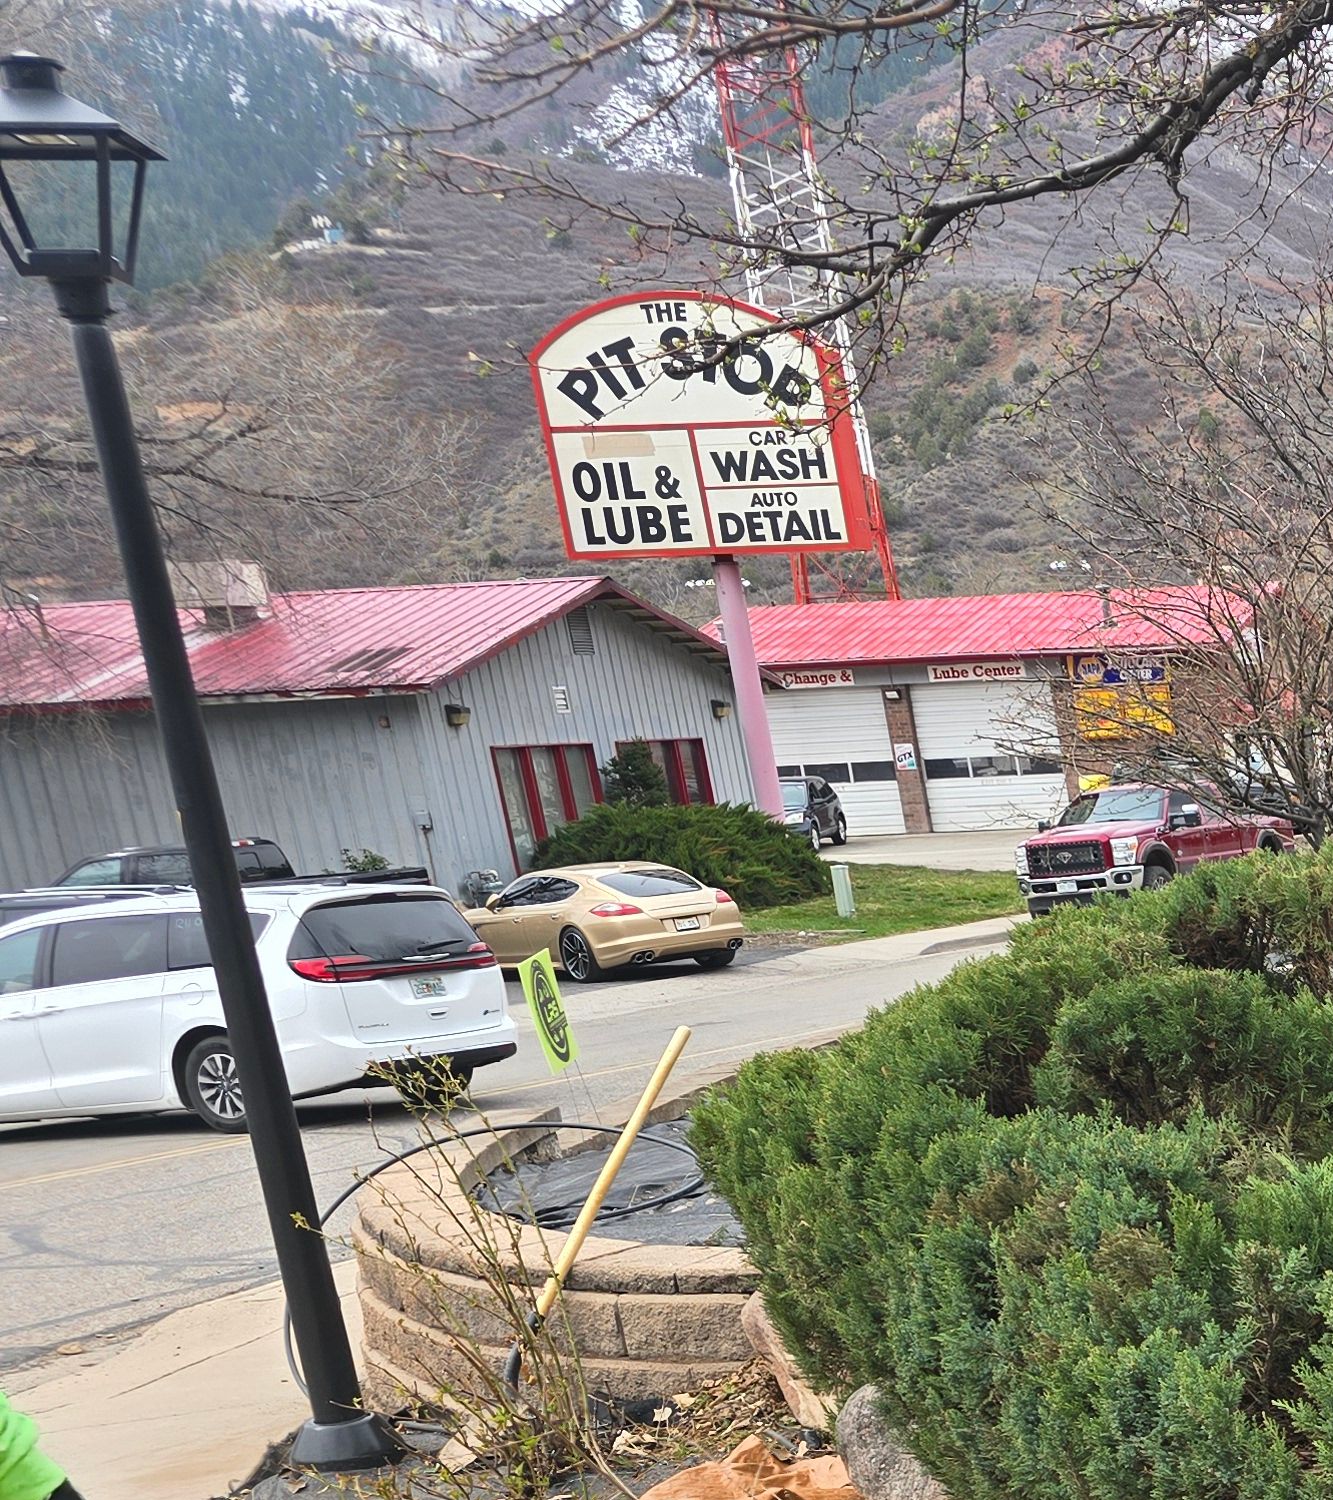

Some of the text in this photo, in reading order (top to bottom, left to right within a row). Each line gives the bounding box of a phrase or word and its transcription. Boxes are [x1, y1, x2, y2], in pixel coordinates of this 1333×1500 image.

[640, 302, 687, 324] THE
[557, 326, 812, 421] PIT STOP
[748, 431, 787, 446] CAR
[709, 448, 827, 483] WASH
[572, 461, 683, 503] OIL &
[750, 491, 798, 507] AUTO
[581, 504, 693, 545] LUBE
[717, 509, 842, 544] DETAIL
[783, 669, 852, 686] Change &
[932, 665, 1021, 680] Lube Center
[897, 751, 913, 763] GTX
